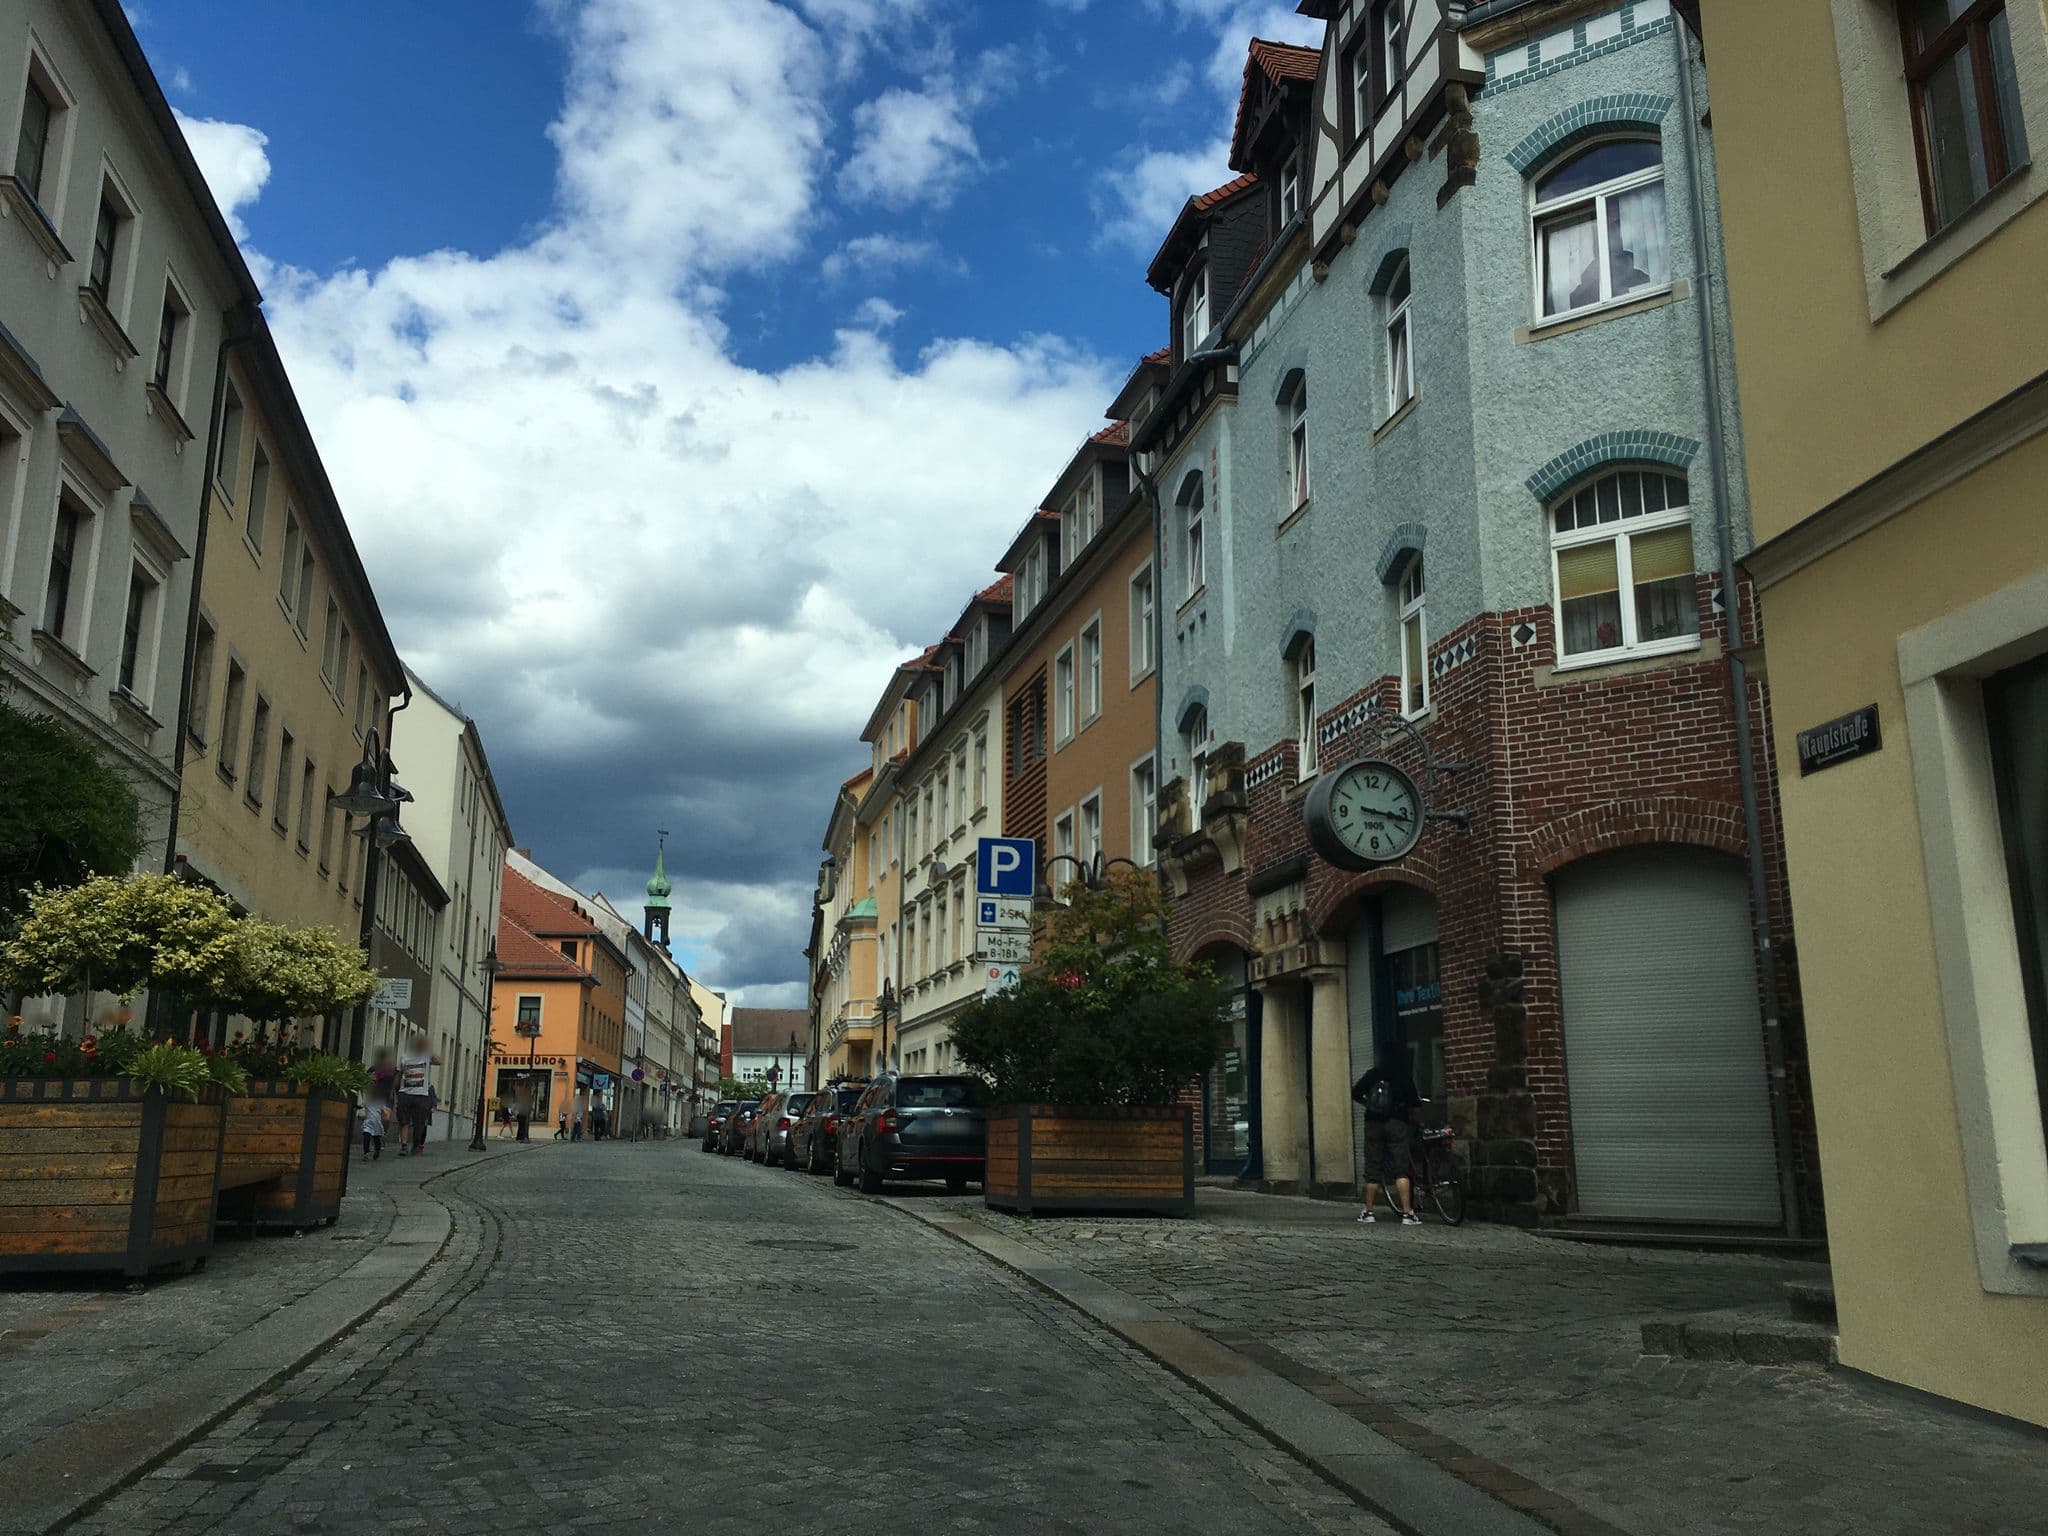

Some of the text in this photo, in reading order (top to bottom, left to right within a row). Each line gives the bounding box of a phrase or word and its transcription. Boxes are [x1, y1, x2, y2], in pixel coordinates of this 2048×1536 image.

[1802, 714, 1869, 759] Hauptstraße
[1364, 775, 1379, 788] 12
[1339, 805, 1348, 817] 9
[1399, 807, 1407, 819] 3
[1364, 821, 1384, 830] 1905
[1370, 836, 1379, 849] 6
[991, 845, 1020, 887] P
[990, 949, 1018, 959] 8-18h
